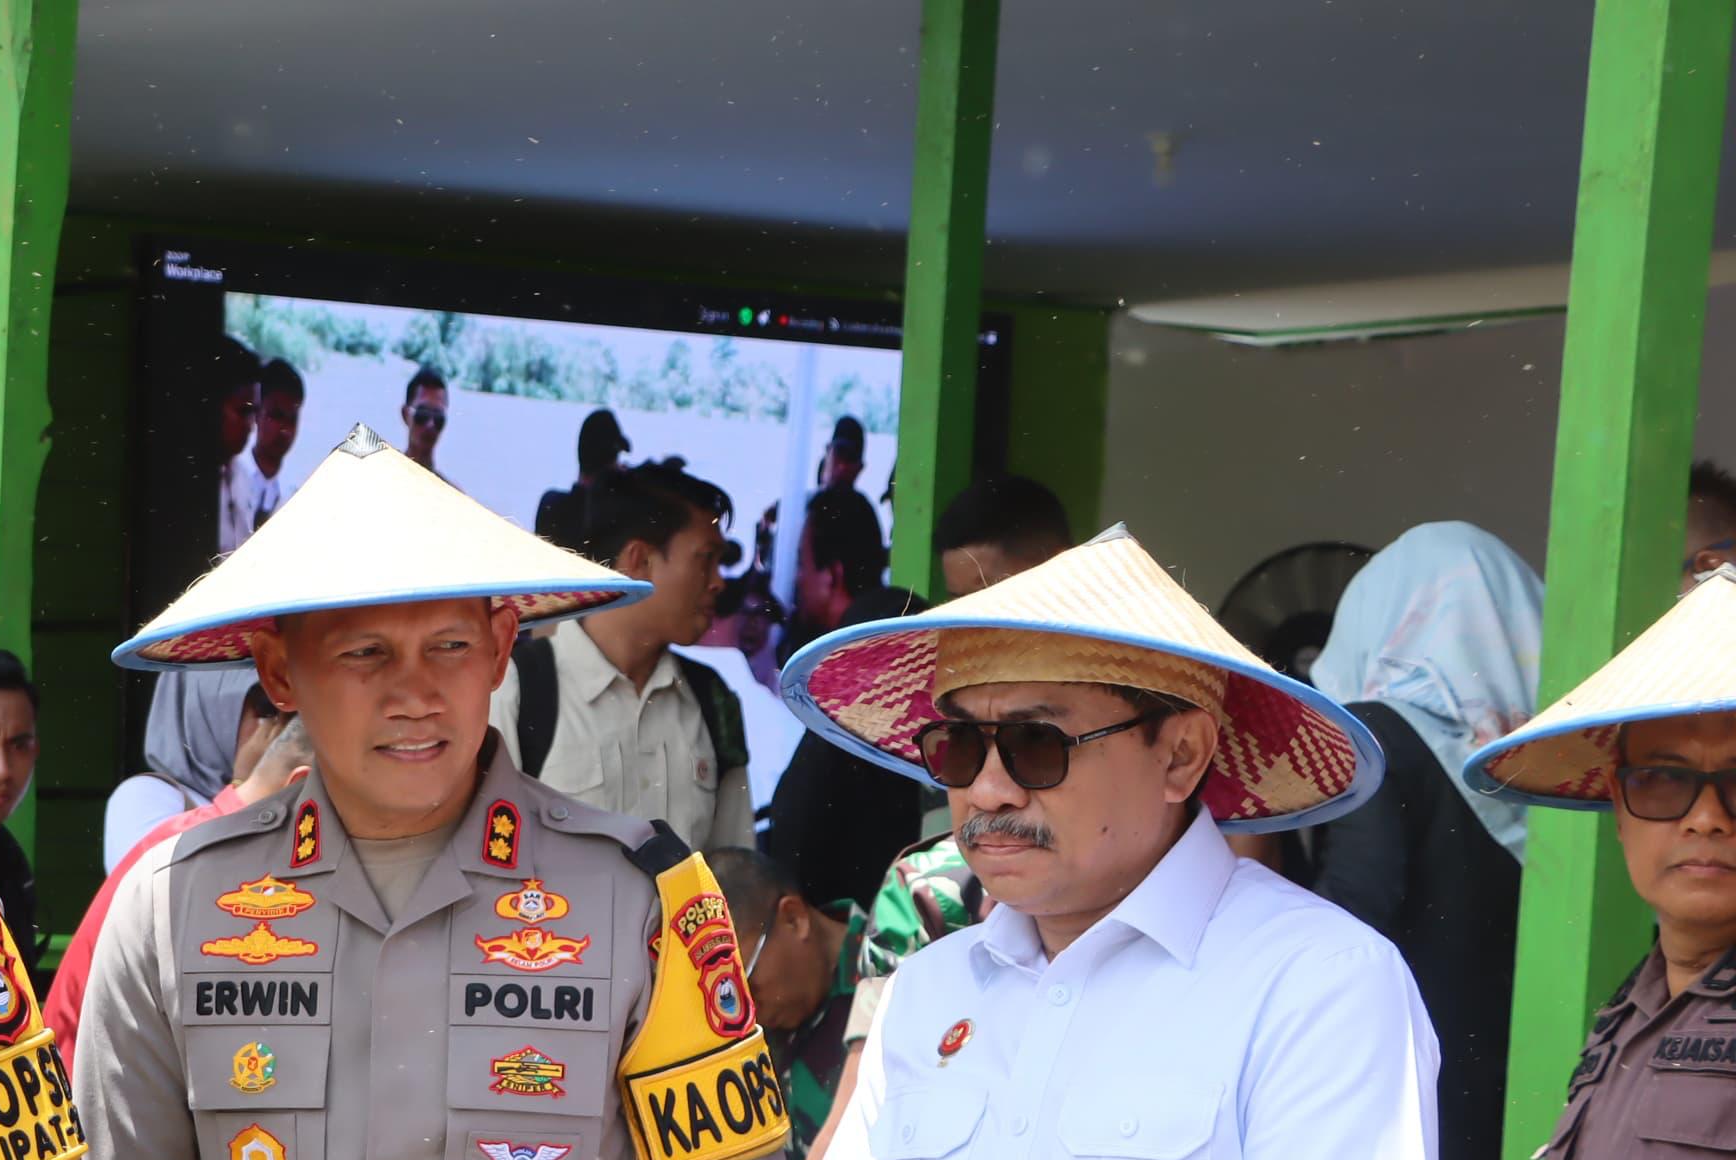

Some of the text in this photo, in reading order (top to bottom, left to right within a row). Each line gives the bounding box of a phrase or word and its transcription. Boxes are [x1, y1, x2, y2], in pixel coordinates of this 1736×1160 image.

[166, 264, 224, 281] Workplace
[196, 980, 318, 1017] ERWIN
[465, 983, 594, 1021] POLRI
